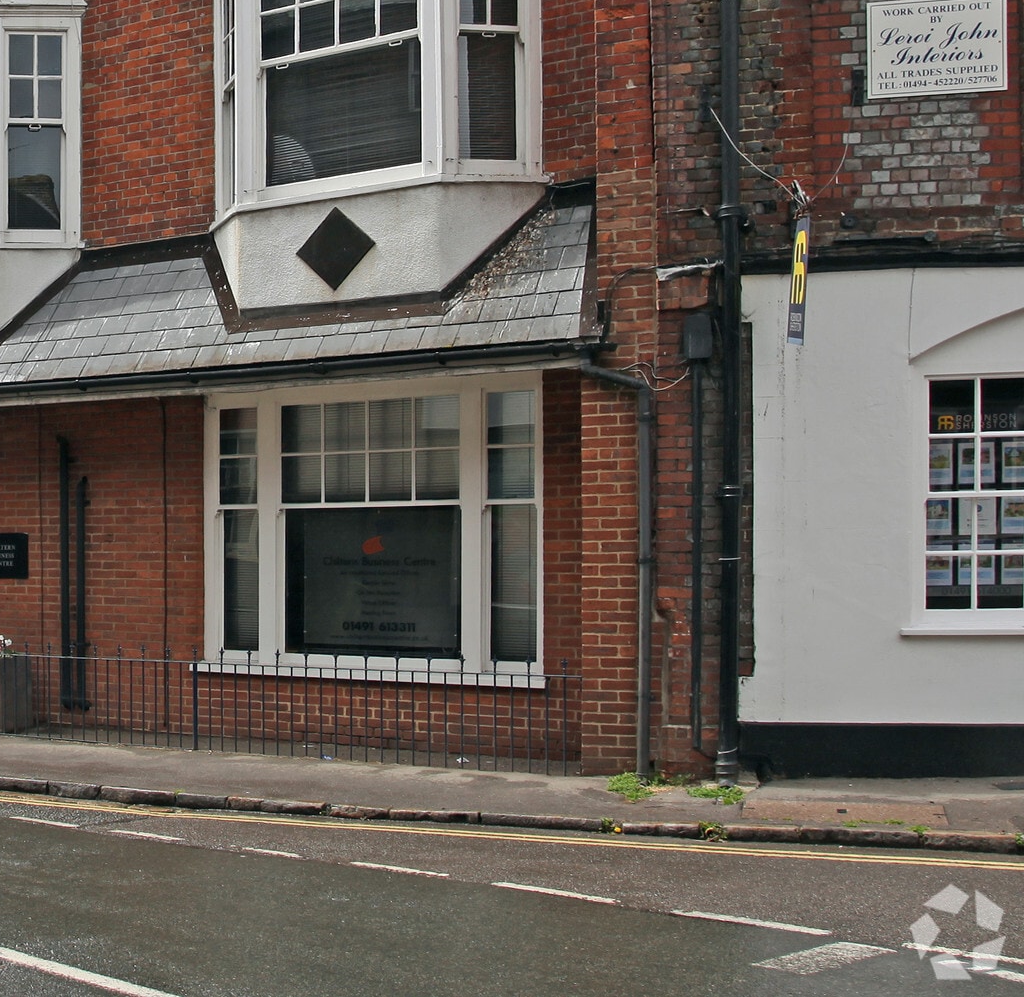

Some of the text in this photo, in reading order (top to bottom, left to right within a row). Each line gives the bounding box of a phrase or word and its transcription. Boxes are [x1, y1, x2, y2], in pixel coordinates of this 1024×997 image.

[883, 2, 991, 17] WORK CARRIED OUT
[930, 15, 943, 24] BY
[877, 21, 998, 49] Leroi John
[890, 46, 983, 66] Interiors
[877, 64, 998, 80] ALL TRADES SUPPLIED
[342, 621, 416, 633] 01491 613311
